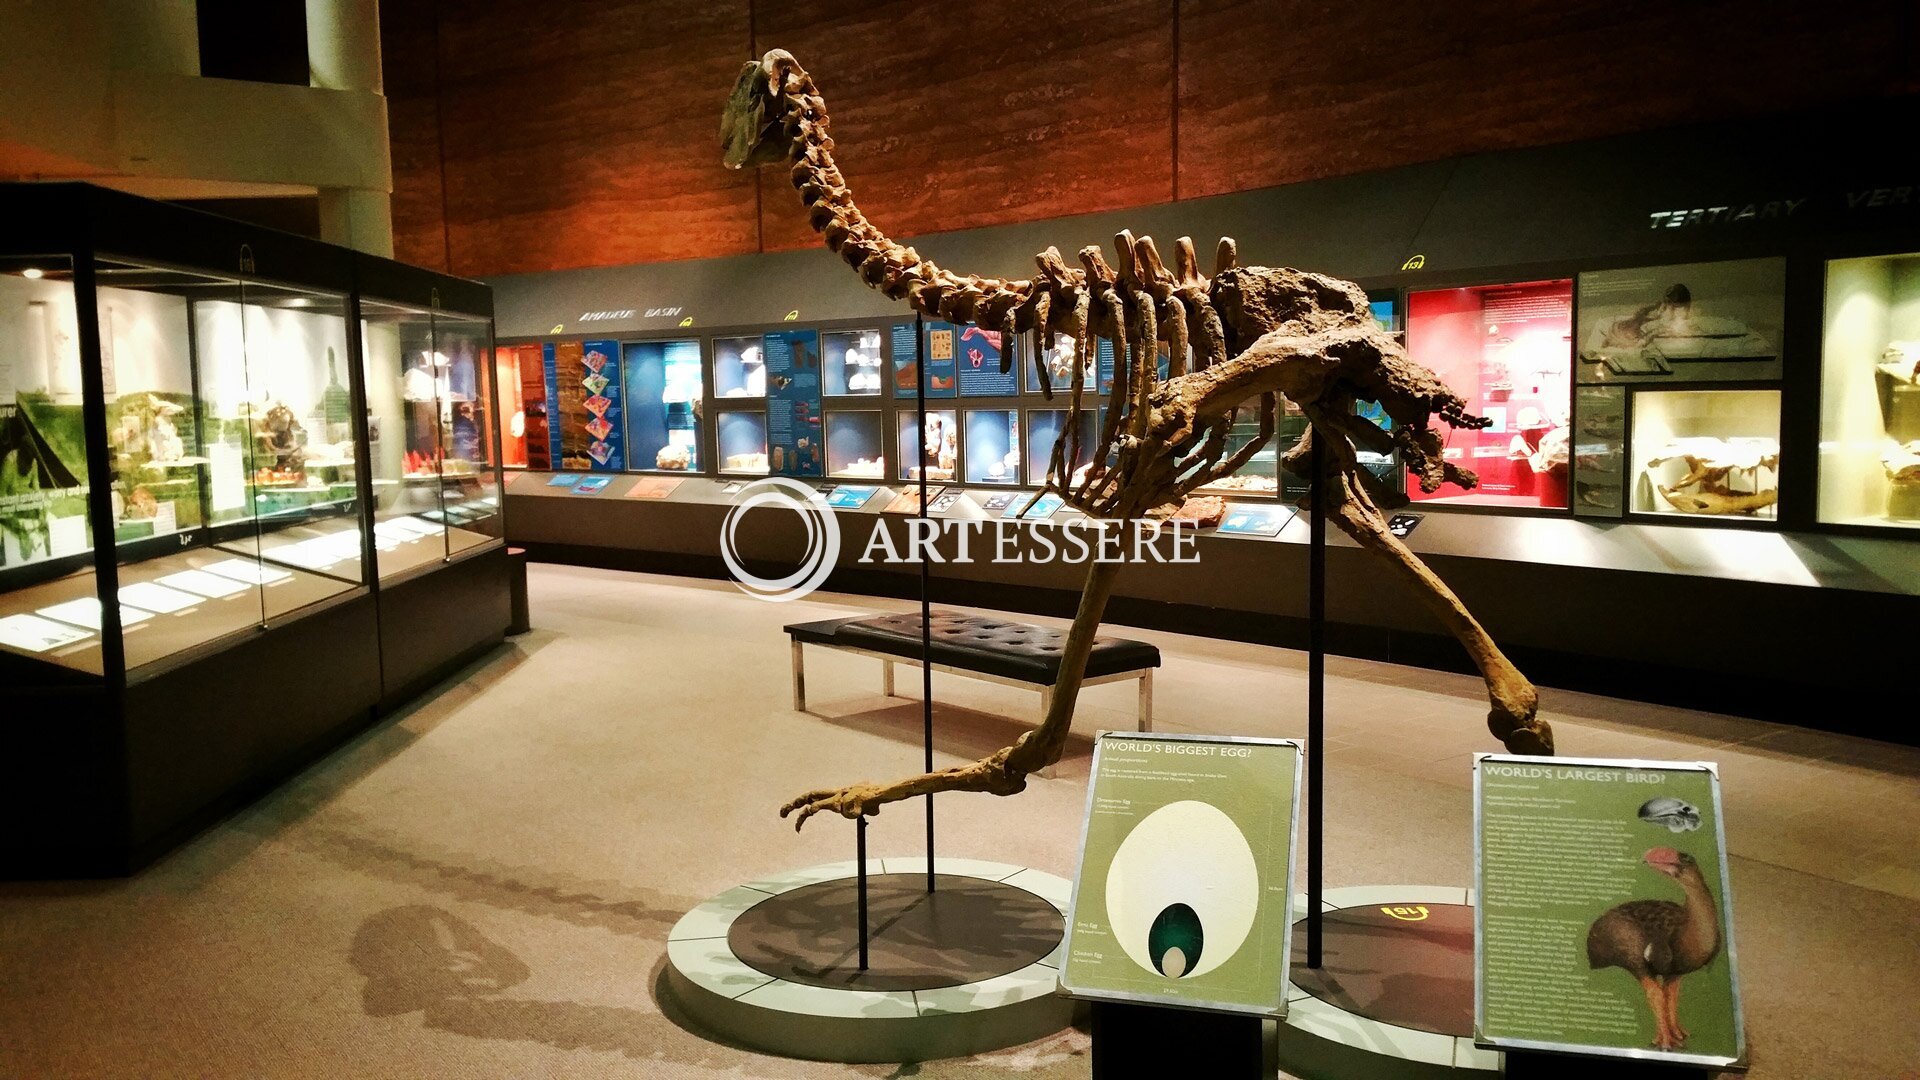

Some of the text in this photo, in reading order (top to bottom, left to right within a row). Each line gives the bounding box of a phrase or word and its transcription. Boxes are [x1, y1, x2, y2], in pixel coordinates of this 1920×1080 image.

[1650, 186, 1920, 229] TERTIARY VER
[644, 306, 683, 318] BASIN
[1104, 741, 1252, 759] WORLD'S BIGGEST EGG?
[1484, 766, 1666, 784] WORLD'S LARGEST BIRD?
